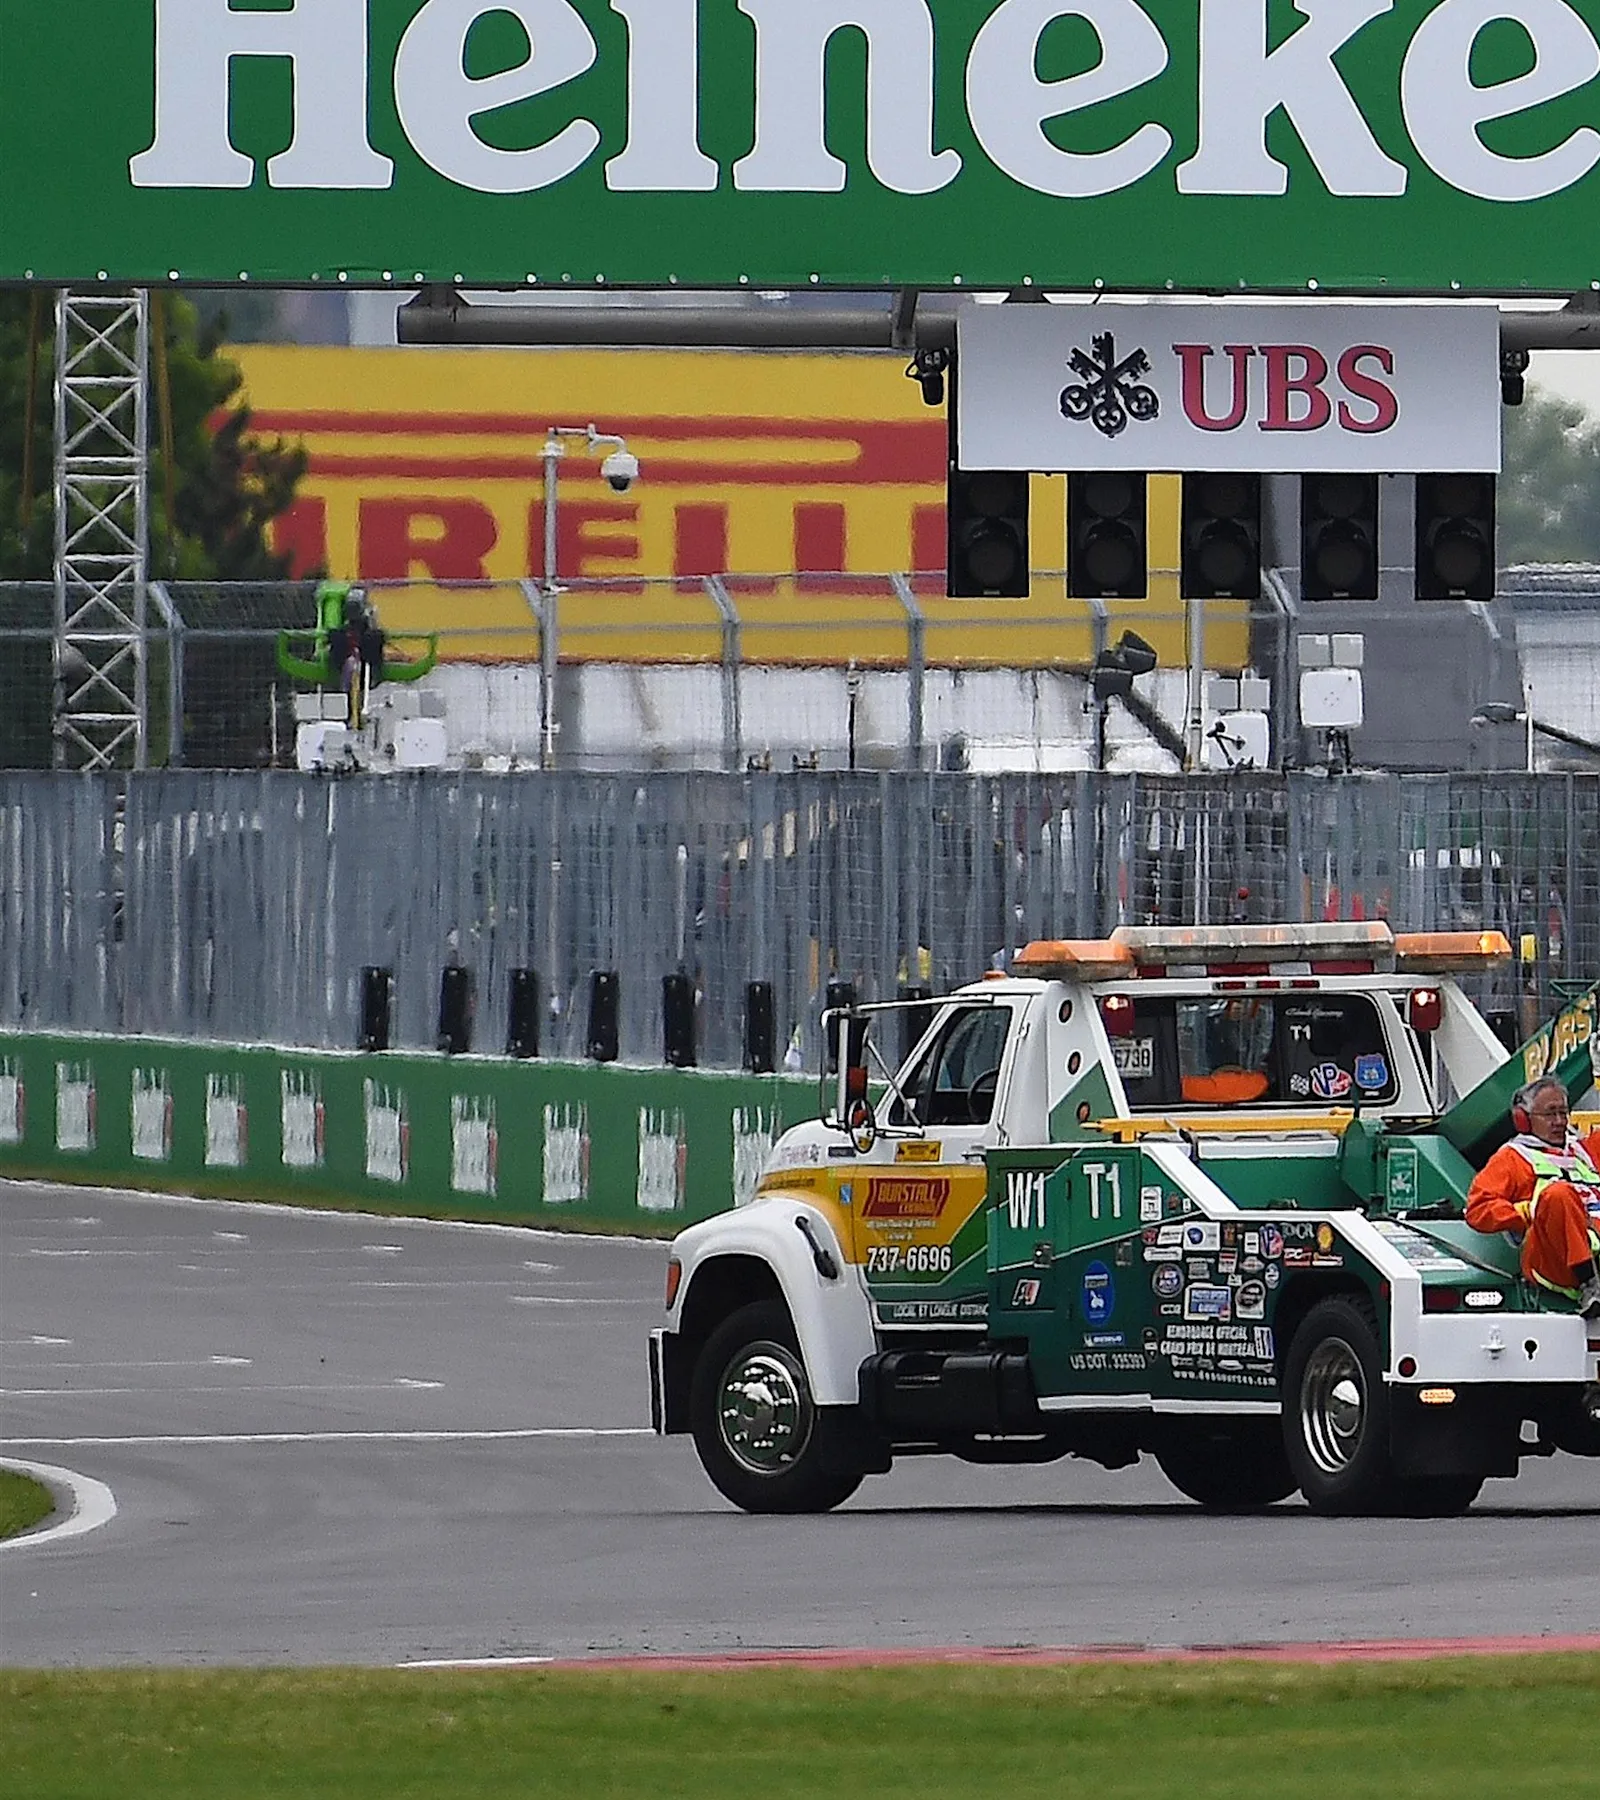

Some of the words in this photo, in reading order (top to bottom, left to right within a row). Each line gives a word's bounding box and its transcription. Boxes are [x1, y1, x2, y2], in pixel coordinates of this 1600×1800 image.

[1172, 343, 1400, 434] UBS
[1290, 1024, 1312, 1041] T1
[877, 1182, 936, 1203] BURSTALL
[1007, 1172, 1045, 1228] W1
[1082, 1161, 1121, 1219] T1
[867, 1246, 951, 1272] 737-6696
[1070, 1354, 1086, 1370] US
